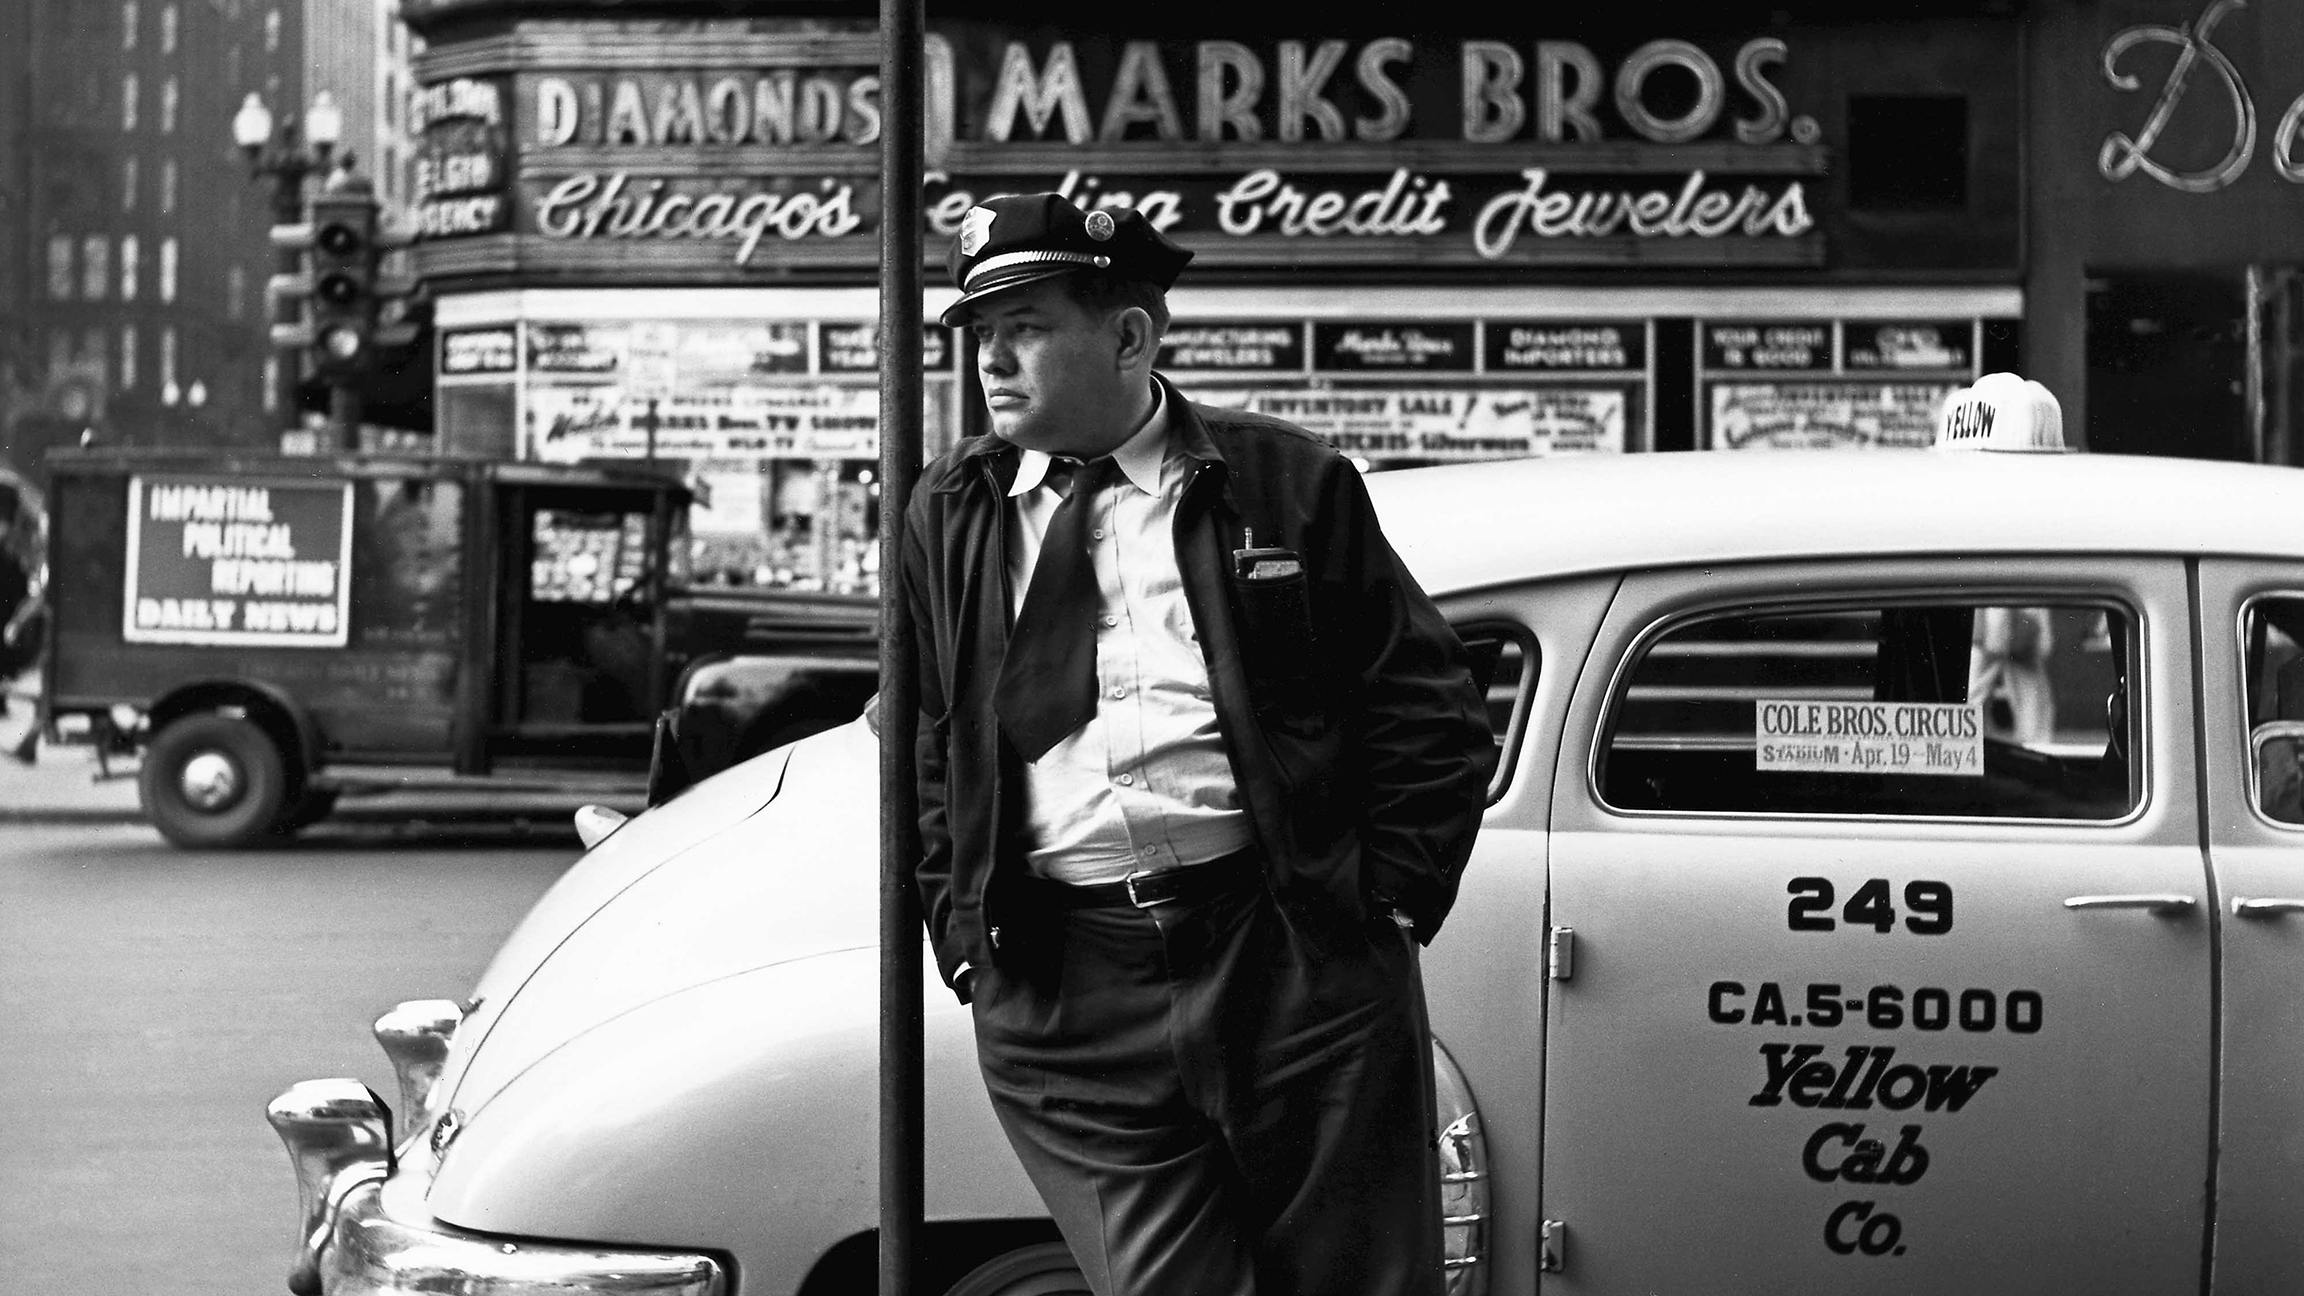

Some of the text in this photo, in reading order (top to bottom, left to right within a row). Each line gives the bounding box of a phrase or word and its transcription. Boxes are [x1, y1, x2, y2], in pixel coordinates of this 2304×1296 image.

[536, 77, 881, 147] DIAMONDS
[985, 37, 1822, 145] MARKS BROS.
[537, 171, 861, 265] Chicago's
[1216, 168, 1451, 236] Credit
[1473, 167, 1814, 260] Jewelers
[1503, 349, 1627, 368] IMPORTERS
[1510, 327, 1620, 349] DIAMOND
[1945, 400, 1997, 442] YELLOW
[149, 484, 275, 523] IMPARTIAL
[182, 522, 297, 561] POLITICAL
[136, 597, 338, 634] DAILY NEWS
[1762, 704, 1978, 739] COLE BROS. CIRCUS
[1852, 741, 1888, 769] Apr.
[1966, 745, 1978, 768] 4
[1786, 876, 1954, 936] 249
[1747, 1042, 2000, 1113] Yellow
[1801, 1121, 1931, 1187] Cab
[1823, 1200, 1908, 1257] Co.
